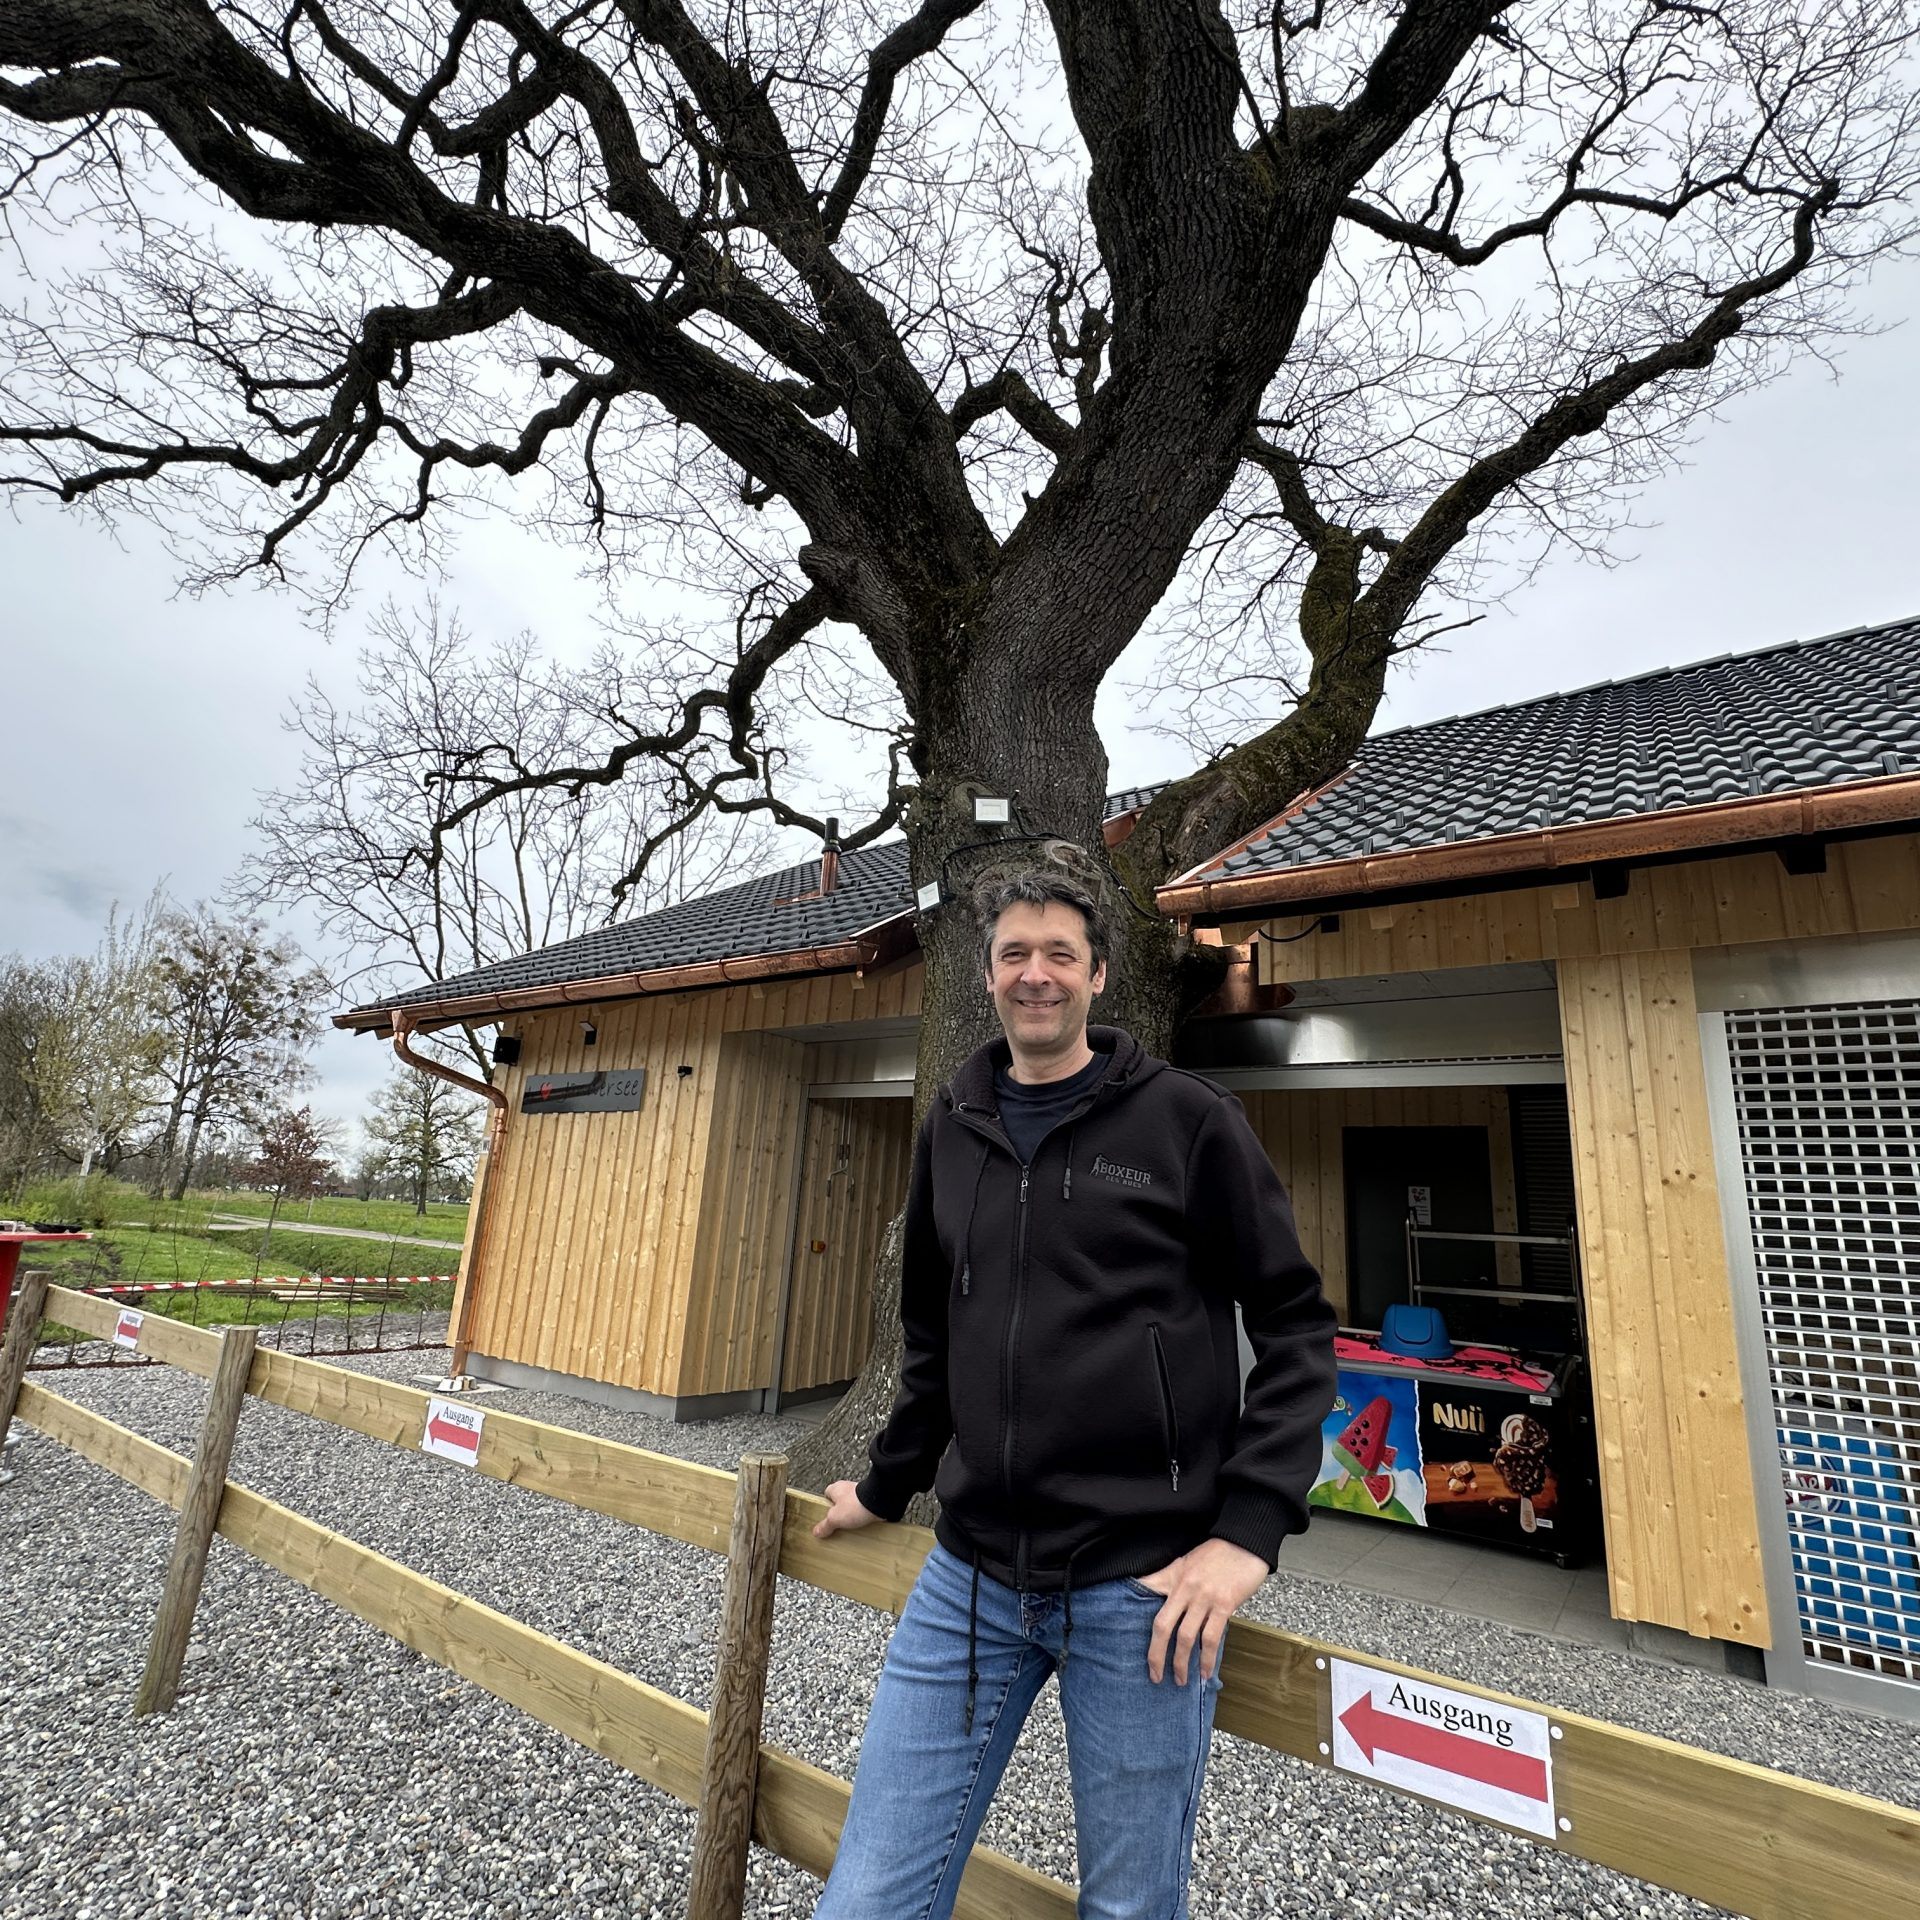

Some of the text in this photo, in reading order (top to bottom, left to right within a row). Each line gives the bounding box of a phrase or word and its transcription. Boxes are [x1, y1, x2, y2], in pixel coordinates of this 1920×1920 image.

[1100, 1162, 1151, 1185] BOXEUR
[442, 1405, 475, 1430] Ausgang
[1432, 1402, 1486, 1433] Nuii
[1387, 1682, 1514, 1747] Ausgang
